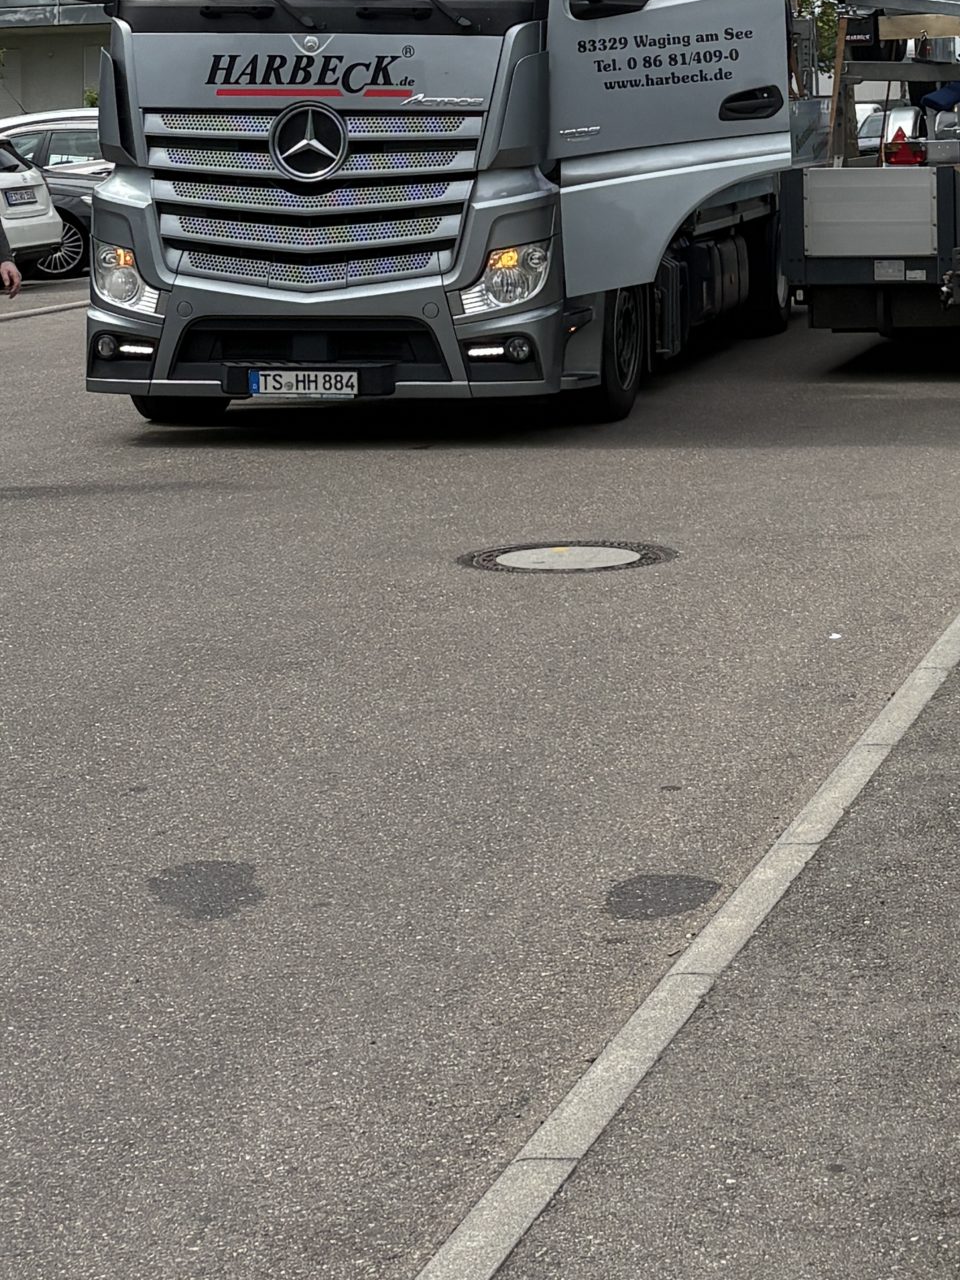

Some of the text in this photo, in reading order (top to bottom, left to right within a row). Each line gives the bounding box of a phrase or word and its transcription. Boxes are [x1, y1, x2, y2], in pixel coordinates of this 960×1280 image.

[577, 27, 753, 53] 83329 Waging am See
[594, 48, 739, 73] Tel. 0 86 81/409-0
[604, 68, 733, 90] www.harbeck.de
[260, 373, 283, 391] TS
[295, 373, 318, 391] HH
[322, 374, 355, 391] 884
